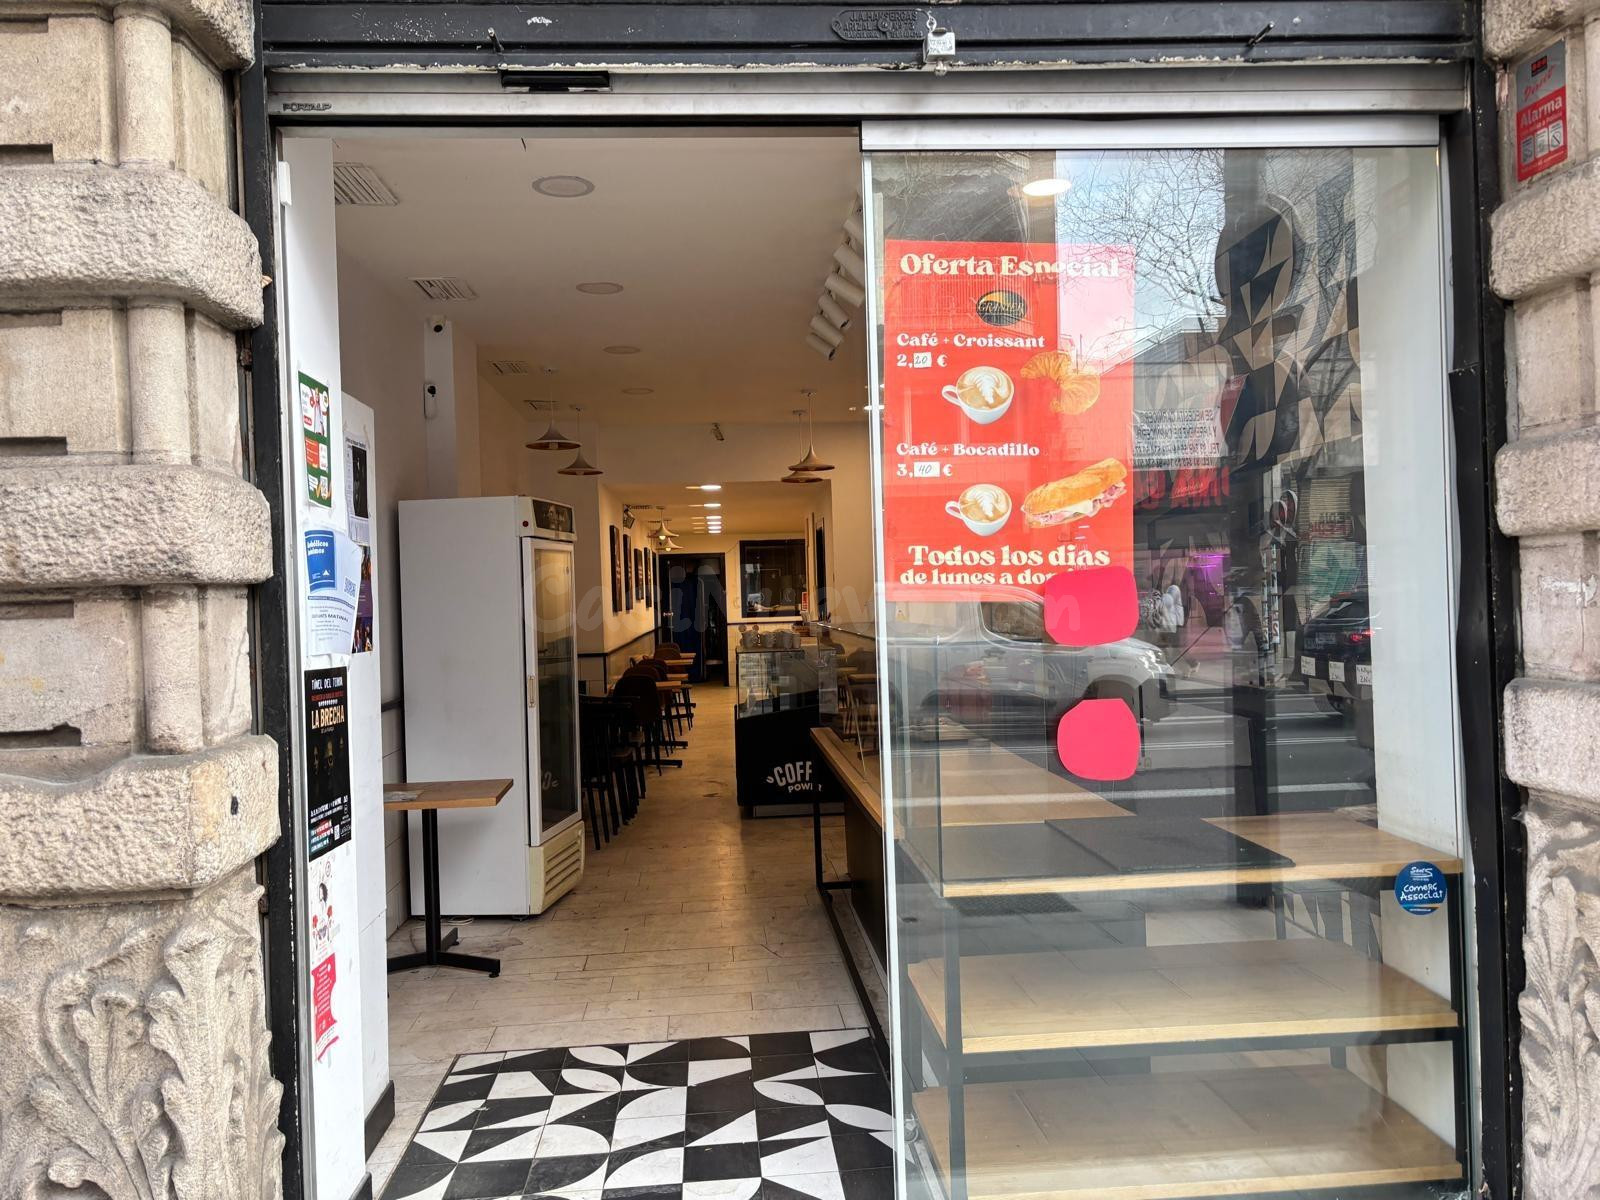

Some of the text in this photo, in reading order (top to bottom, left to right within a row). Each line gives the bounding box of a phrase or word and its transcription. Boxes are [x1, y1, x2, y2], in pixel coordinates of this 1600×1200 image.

[1521, 95, 1563, 127] Alarma
[900, 253, 996, 276] Oferta
[896, 332, 939, 347] Café
[953, 333, 1046, 348] Croissant
[896, 442, 938, 456] Café
[953, 443, 1040, 456] Bocadillo
[908, 545, 996, 566] Todos
[1000, 545, 1044, 566] los
[900, 569, 927, 585] de
[932, 569, 996, 585] lunes
[999, 573, 1014, 585] a
[311, 705, 345, 729] LA BRECHA
